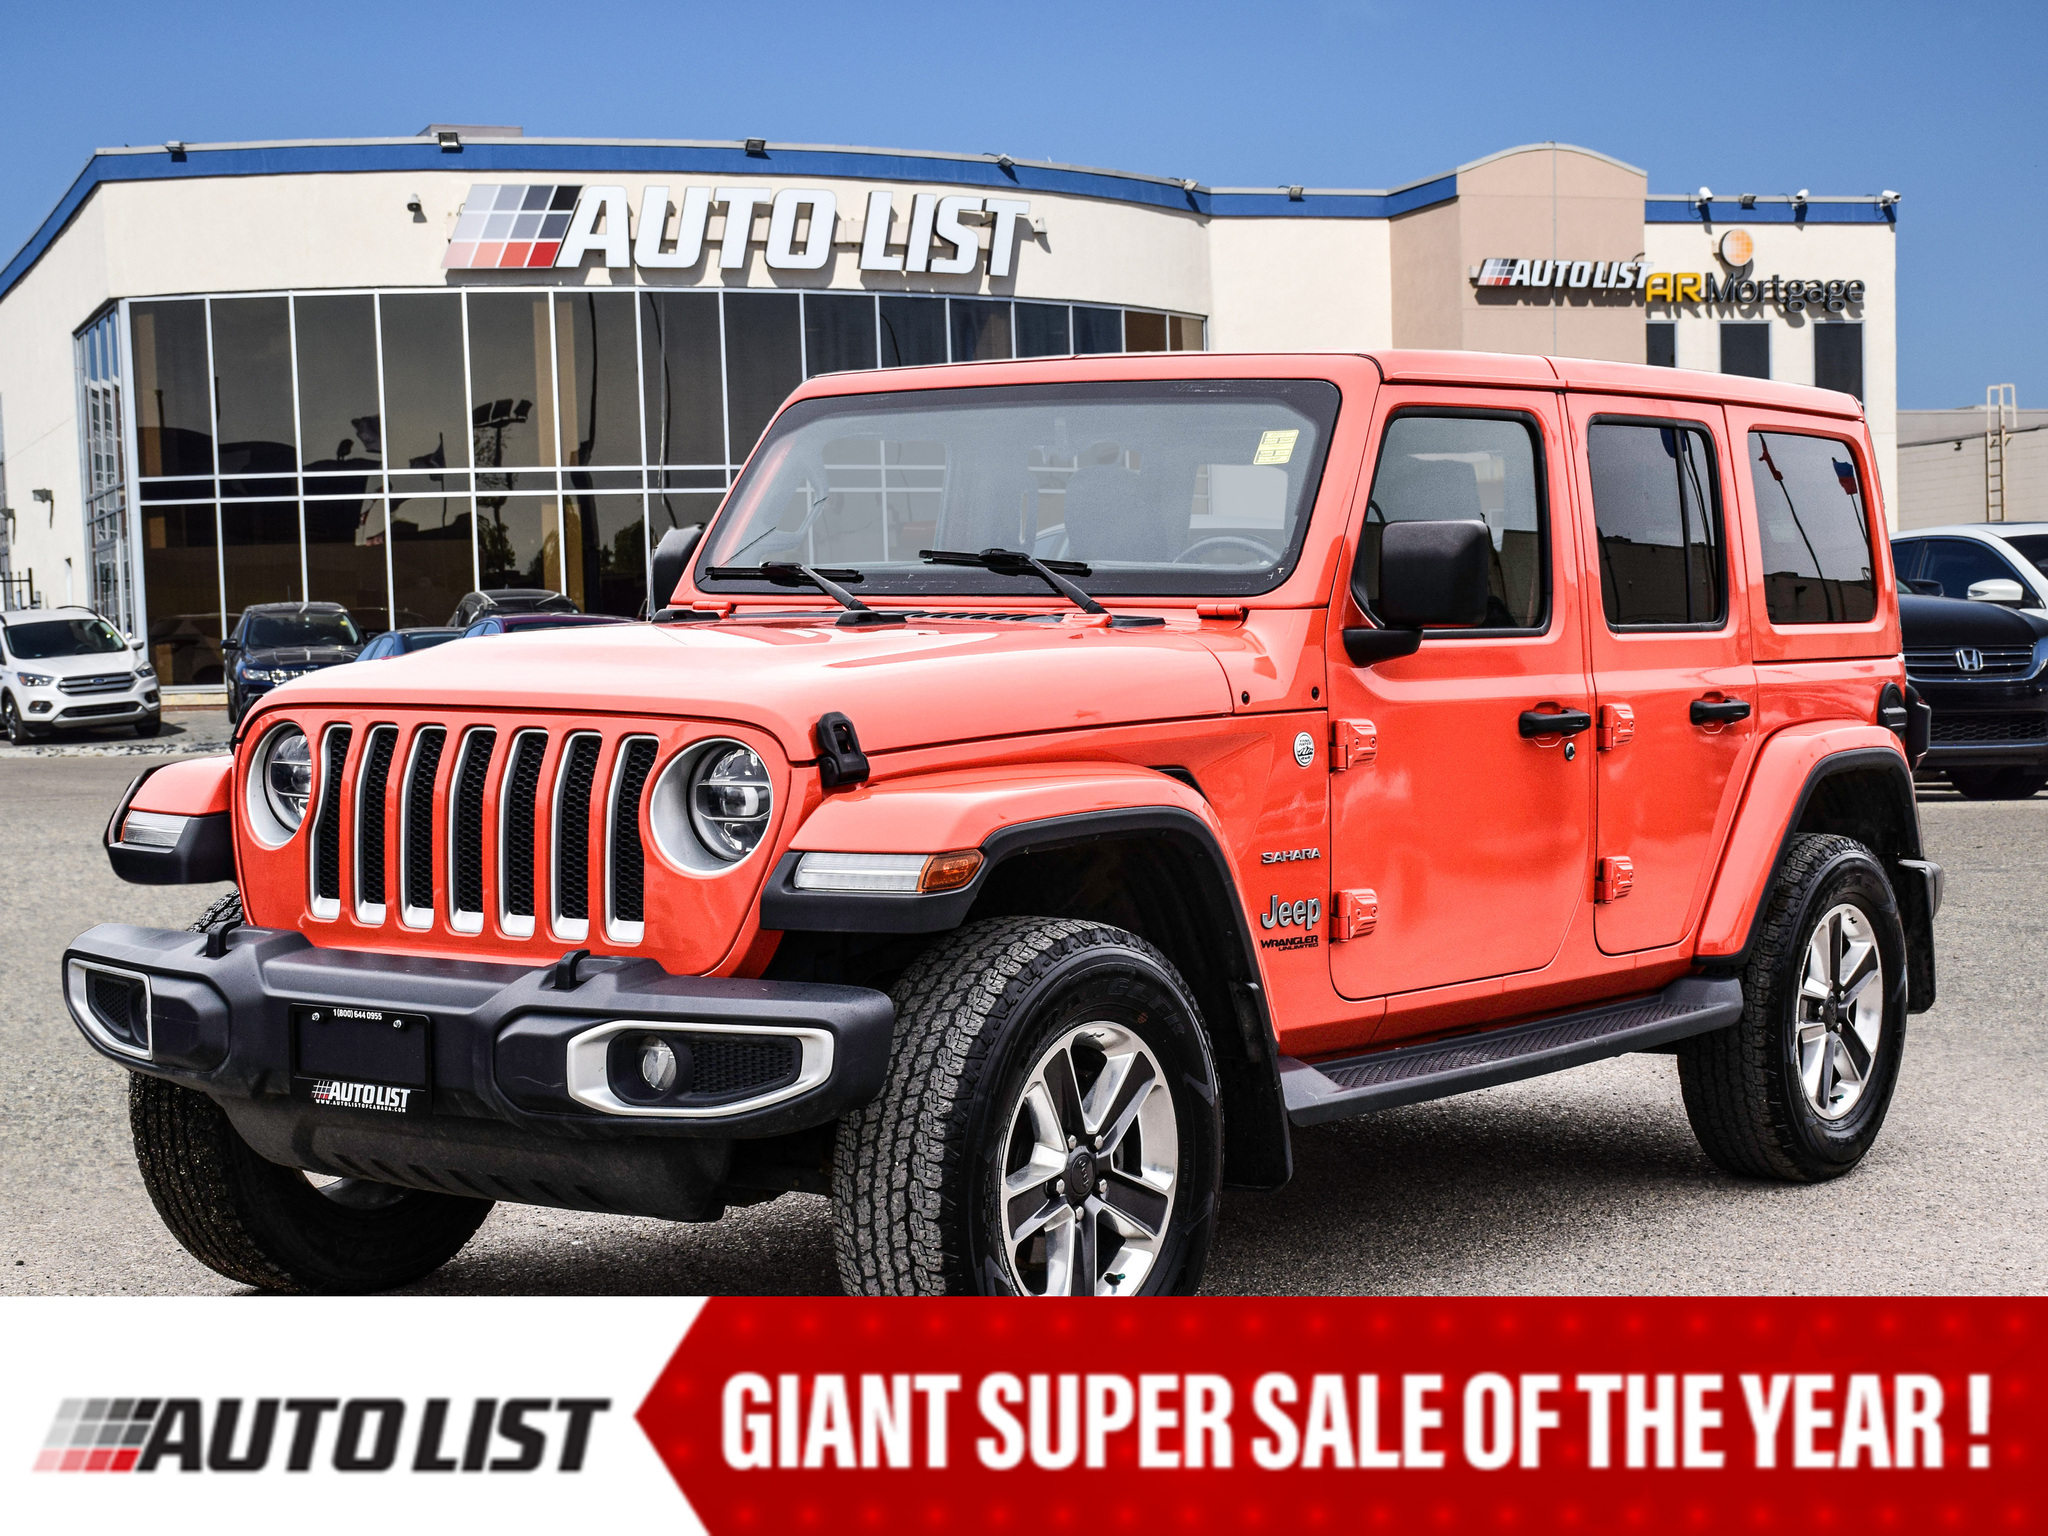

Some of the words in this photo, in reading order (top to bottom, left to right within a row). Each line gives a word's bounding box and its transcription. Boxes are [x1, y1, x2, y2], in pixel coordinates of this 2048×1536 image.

[554, 184, 838, 270] AUTO
[859, 190, 1031, 277] LIST
[1508, 258, 1592, 288] AUTO
[1592, 261, 1654, 289] LIST
[1705, 271, 1866, 313] Mortgage
[1261, 847, 1321, 864] SAHARA
[1261, 894, 1321, 931] Jeep
[1260, 935, 1319, 949] WRANGLER
[1278, 942, 1319, 952] UNLIMITED
[328, 1081, 376, 1104] AUTO
[376, 1086, 411, 1108] LIST
